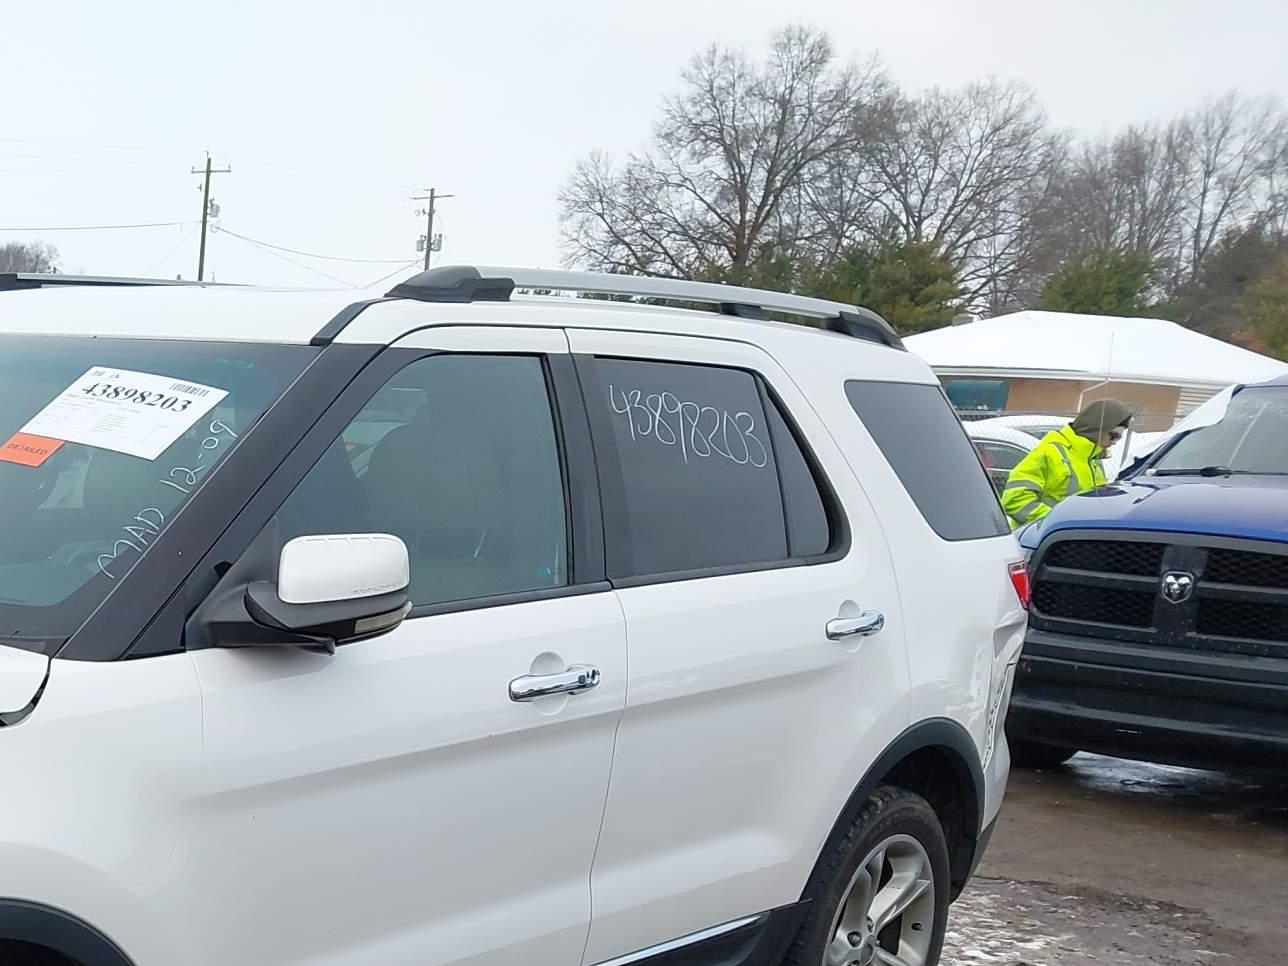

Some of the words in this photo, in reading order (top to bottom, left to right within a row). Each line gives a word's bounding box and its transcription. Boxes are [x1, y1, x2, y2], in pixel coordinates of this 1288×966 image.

[82, 382, 192, 412] 43898203
[609, 384, 768, 468] 43898203
[97, 507, 165, 579] MAD
[159, 420, 239, 494] 12-09
